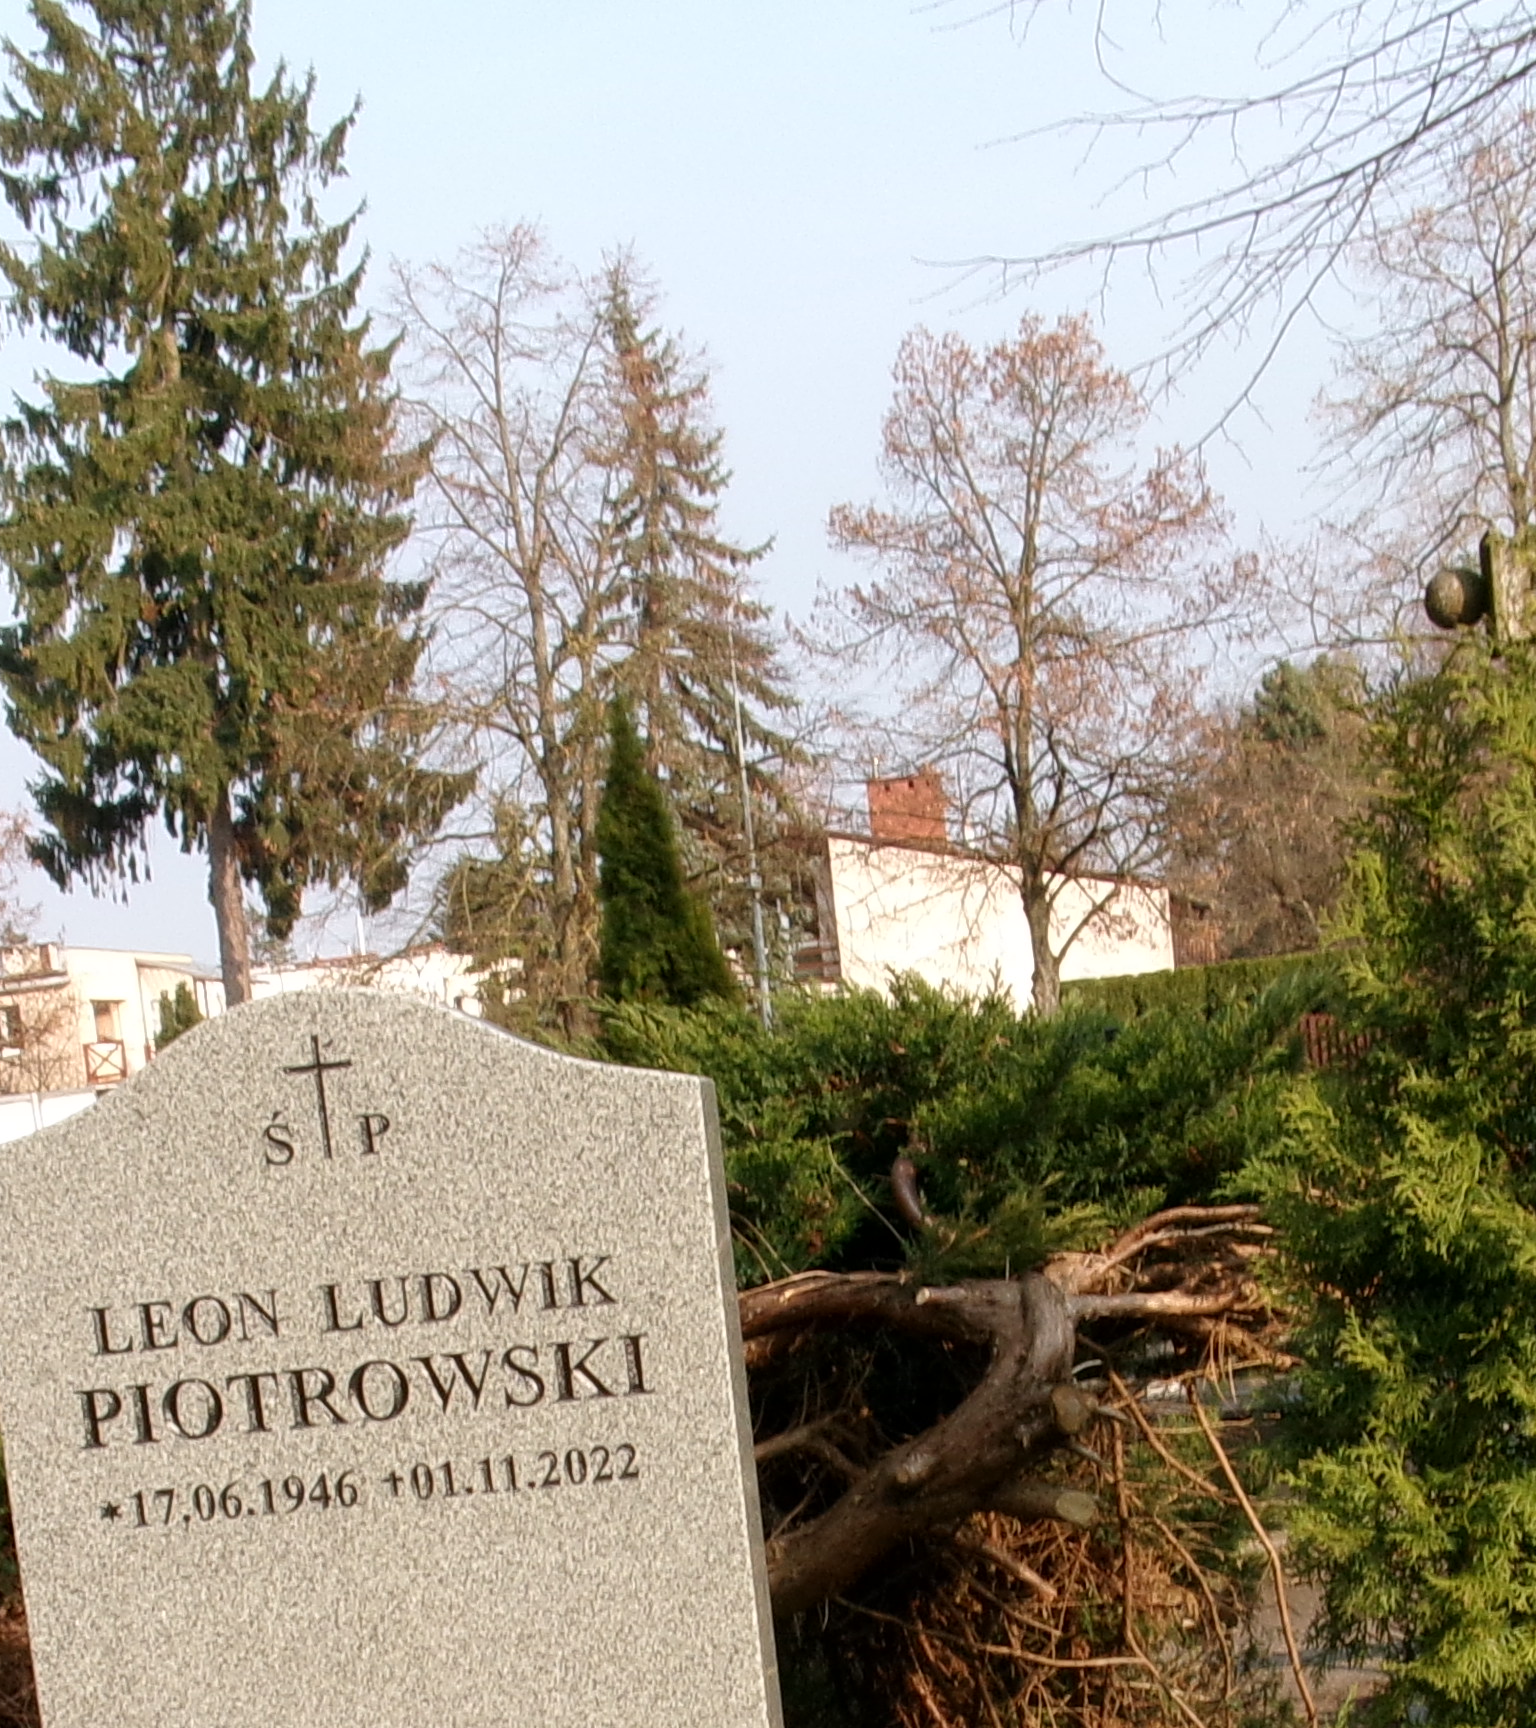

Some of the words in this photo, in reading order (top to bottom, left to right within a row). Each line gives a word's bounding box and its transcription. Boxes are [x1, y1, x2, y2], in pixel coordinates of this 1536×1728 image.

[358, 1113, 391, 1156] P
[86, 1289, 283, 1356] LEON
[322, 1255, 619, 1334] LUDWIK
[74, 1334, 656, 1449] PIOTROWSKI
